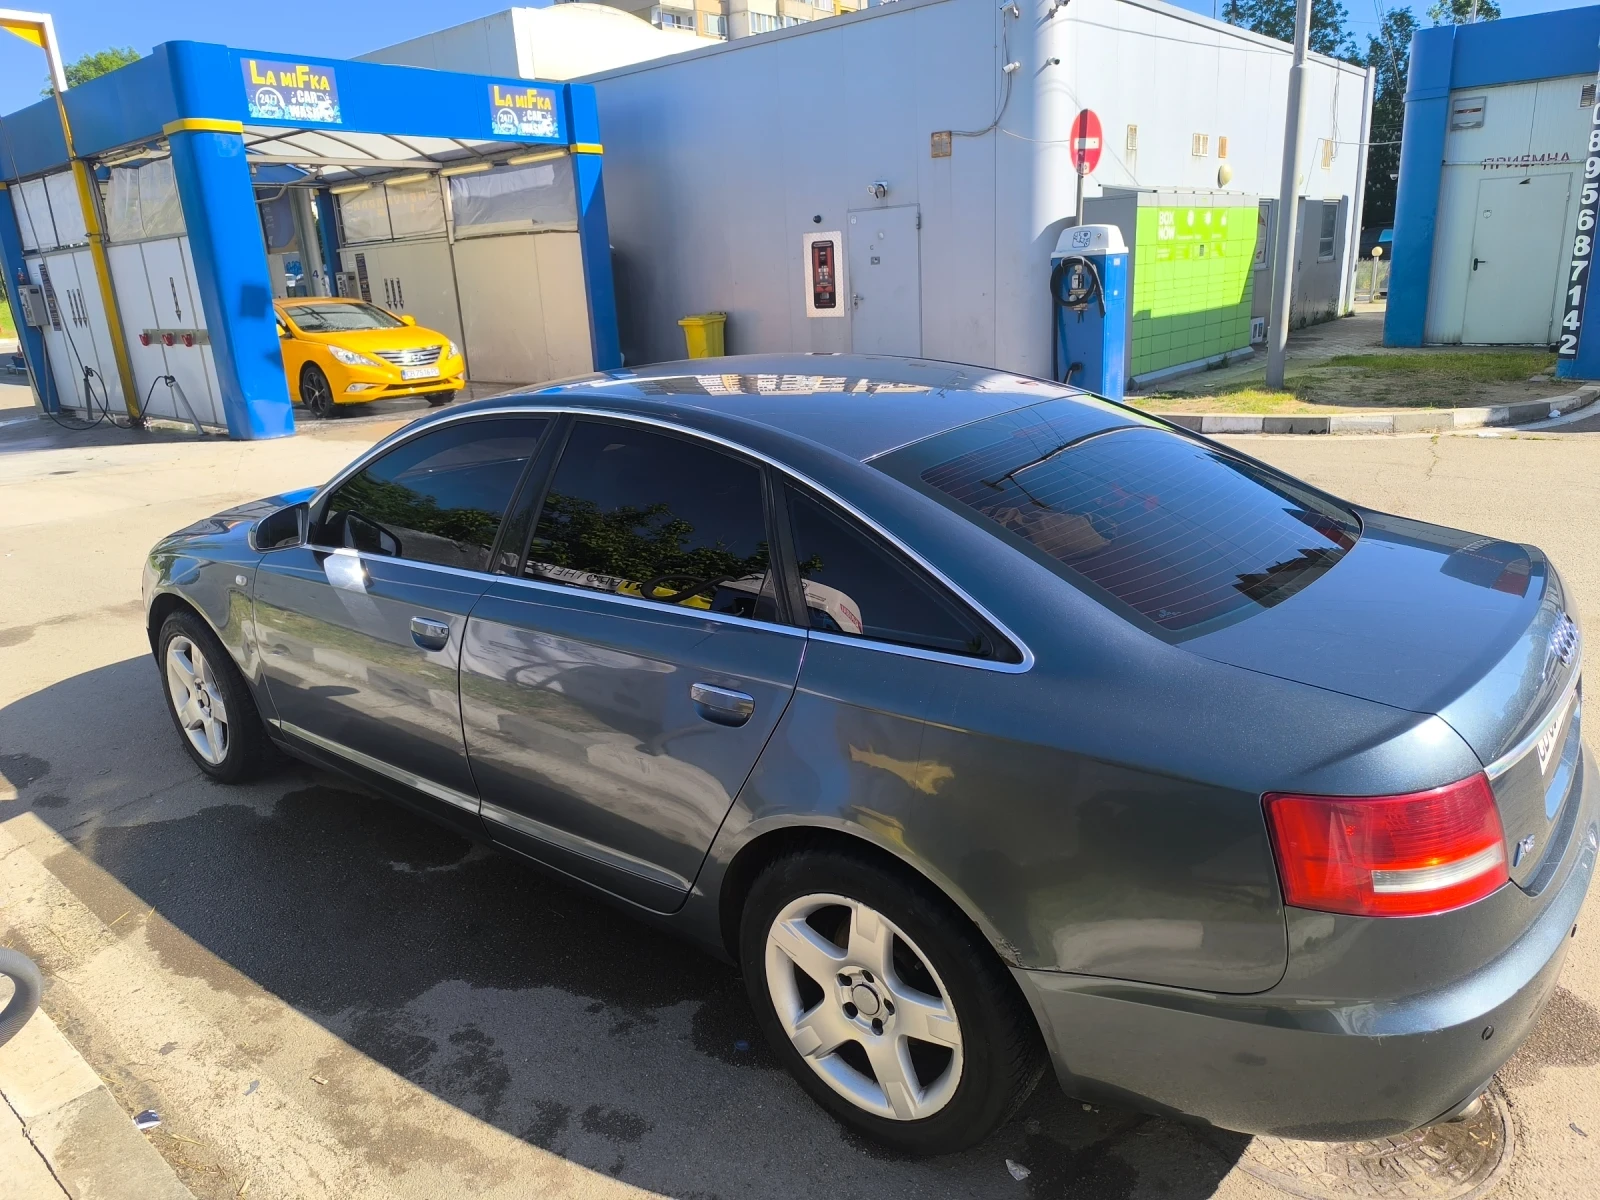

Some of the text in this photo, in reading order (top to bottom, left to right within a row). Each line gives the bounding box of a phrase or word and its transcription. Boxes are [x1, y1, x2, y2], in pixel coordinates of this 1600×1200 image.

[297, 90, 318, 103] CAR
[1483, 151, 1570, 170] ПРИЕМНА
[1159, 211, 1175, 226] BOX
[1158, 226, 1176, 240] NOW
[312, 269, 319, 279] 4
